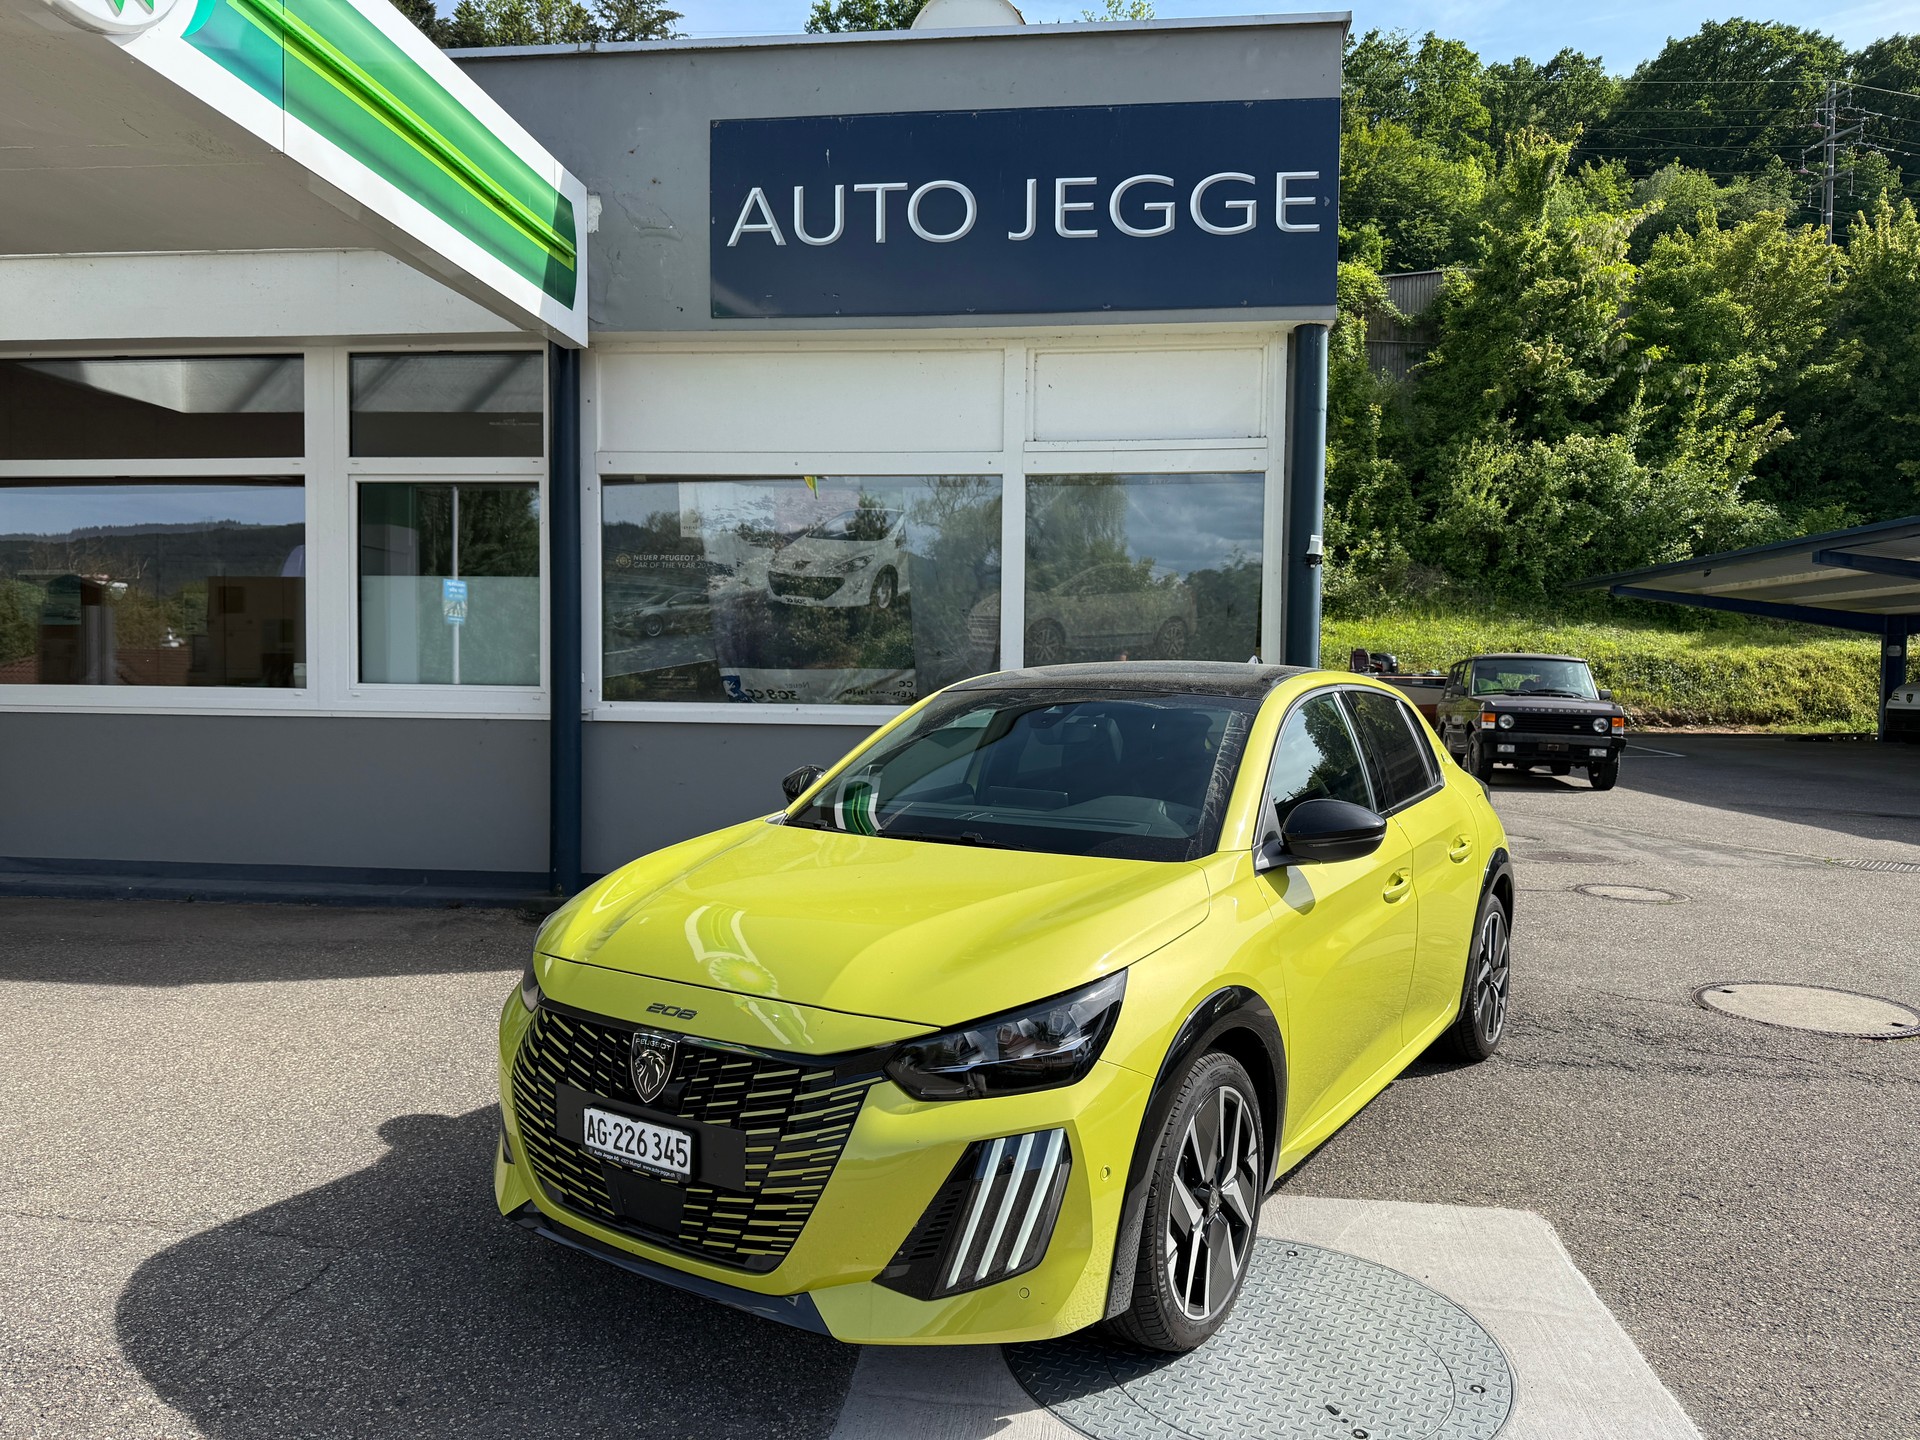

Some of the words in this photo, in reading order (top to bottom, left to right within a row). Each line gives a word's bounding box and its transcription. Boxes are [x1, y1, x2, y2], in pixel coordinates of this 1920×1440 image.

[726, 179, 978, 247] AUTO
[1007, 170, 1321, 241] JEGGE
[633, 561, 648, 569] CAR
[649, 561, 660, 569] OF
[662, 561, 676, 569] THE
[678, 561, 696, 569] YEAR
[645, 1002, 699, 1021] 208
[635, 1037, 672, 1051] PEUGEOT
